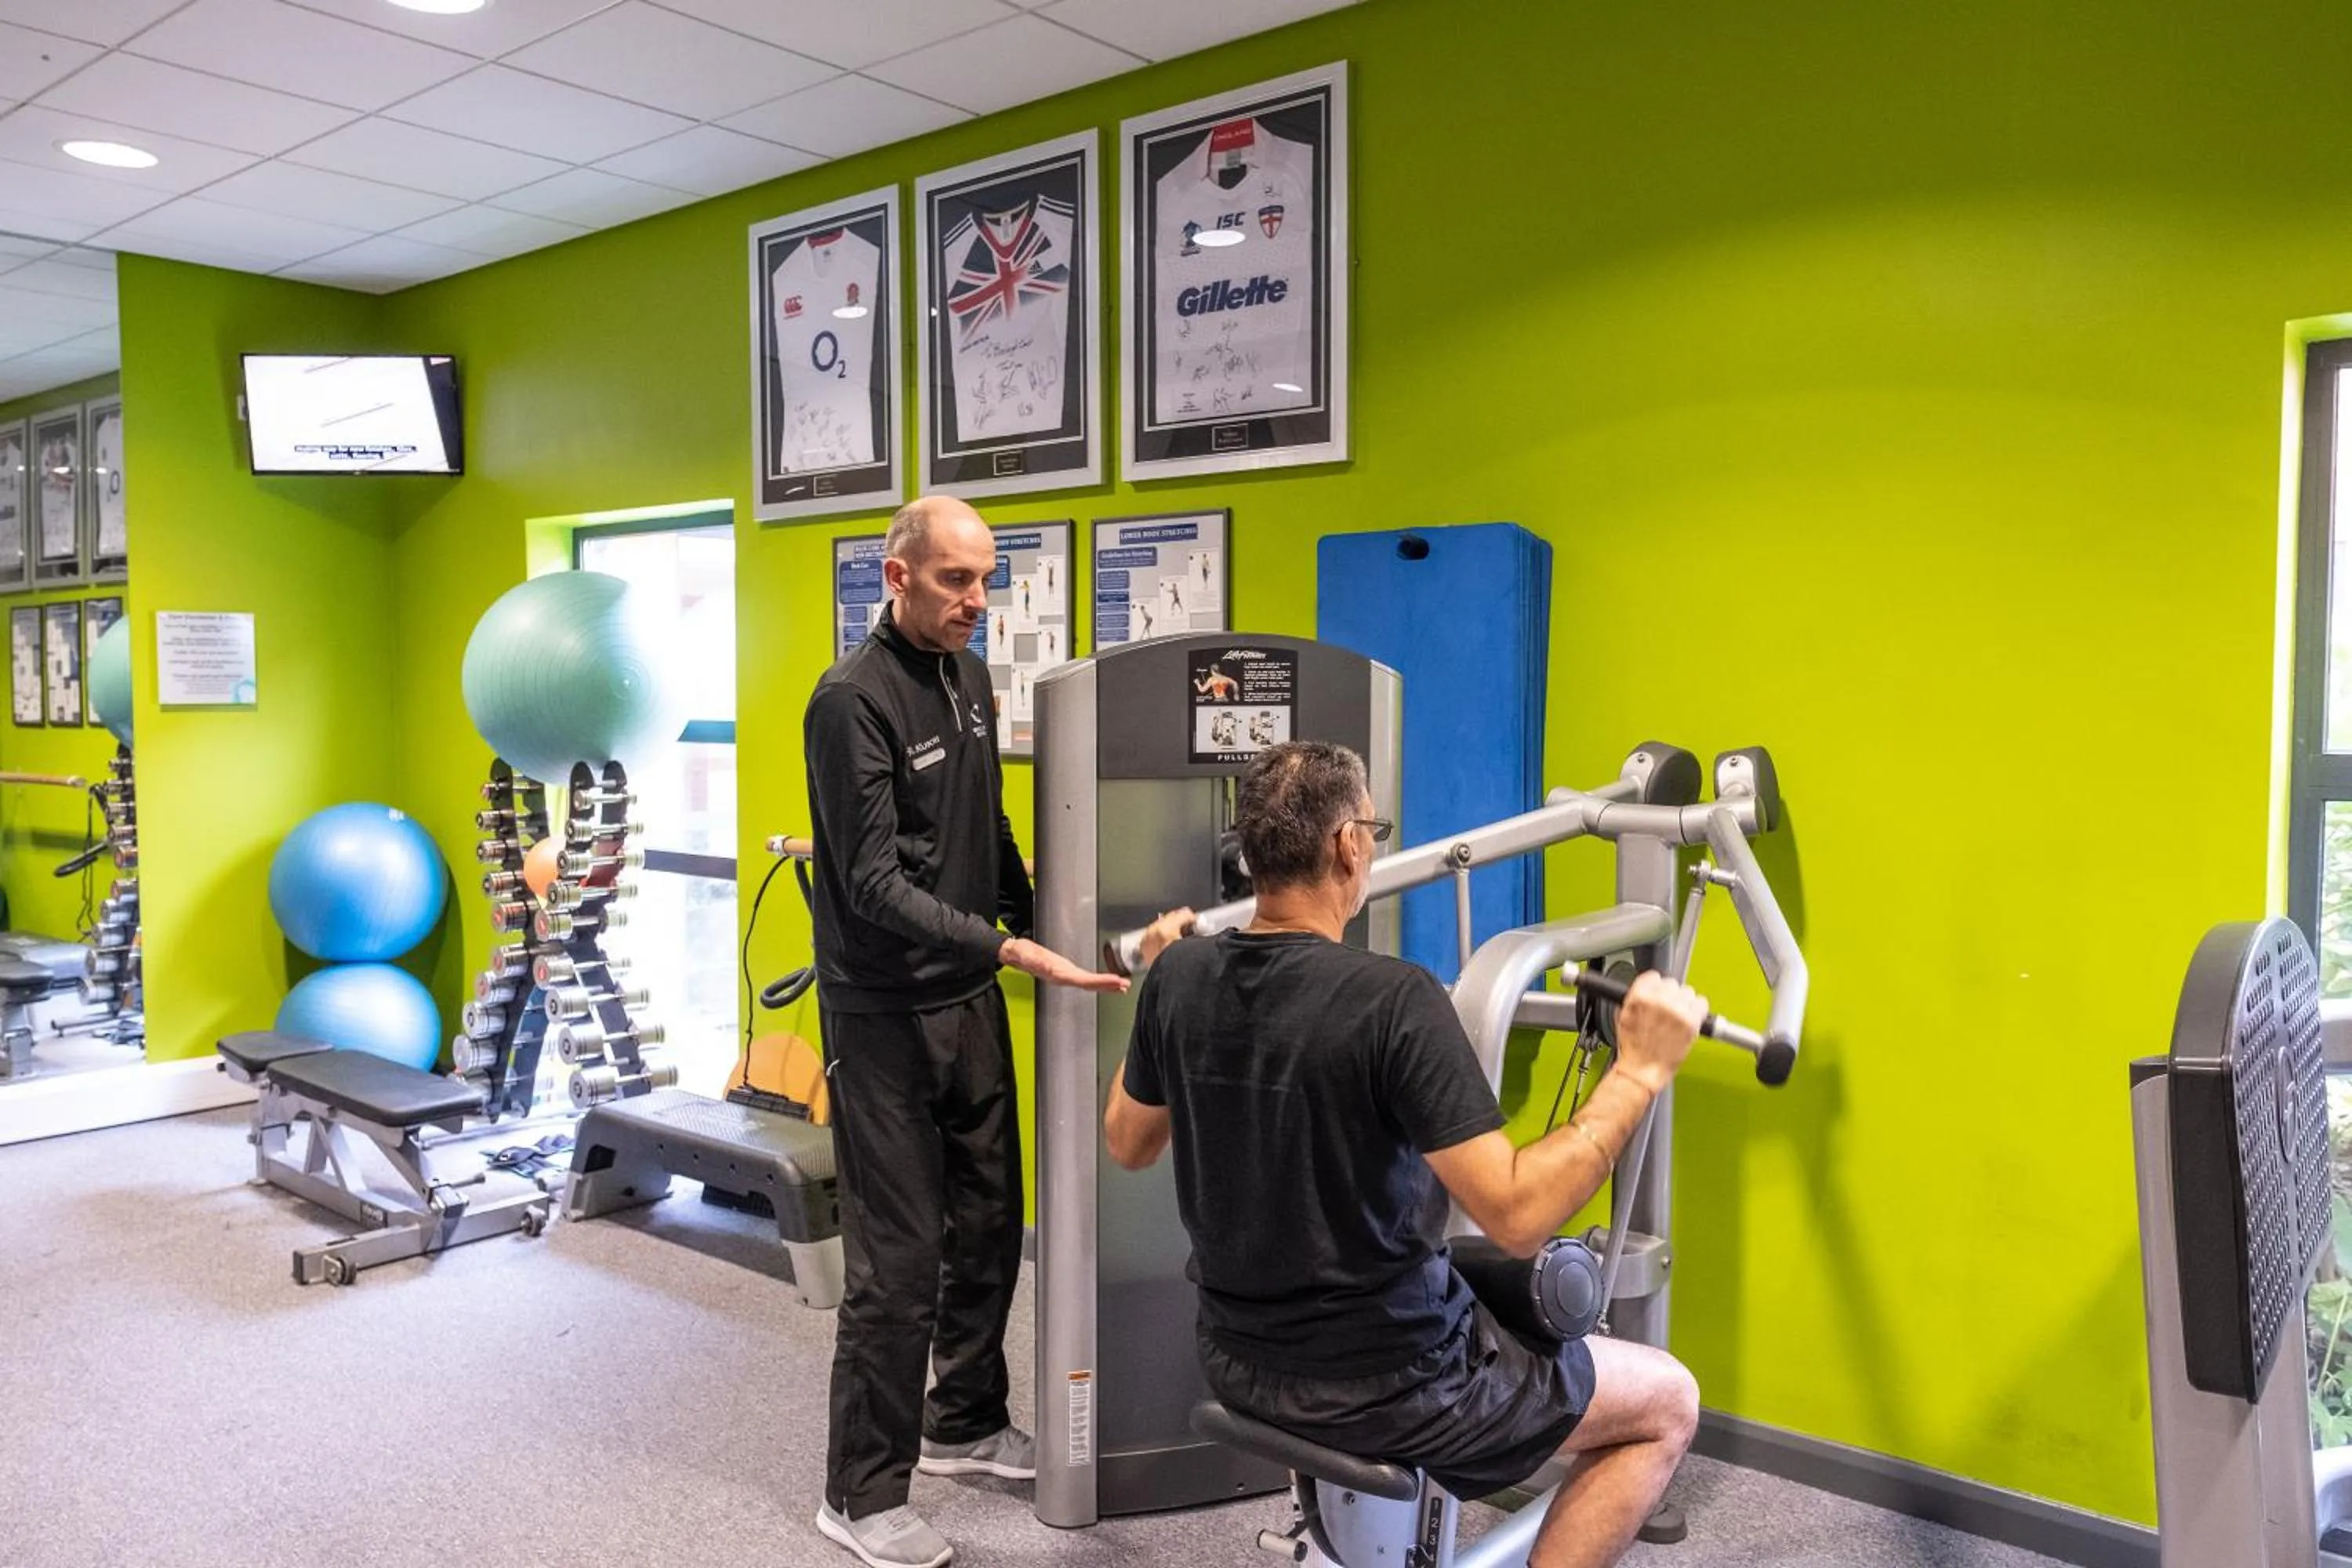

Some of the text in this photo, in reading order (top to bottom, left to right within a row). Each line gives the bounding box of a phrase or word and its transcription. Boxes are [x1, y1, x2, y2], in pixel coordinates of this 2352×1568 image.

[1217, 211, 1247, 230] ISC
[1177, 275, 1288, 318] Gillette
[1120, 532, 1142, 540] LOWER
[1142, 530, 1160, 539] BODY
[1431, 1518, 1439, 1528] 2
[1429, 1534, 1437, 1545] 3
